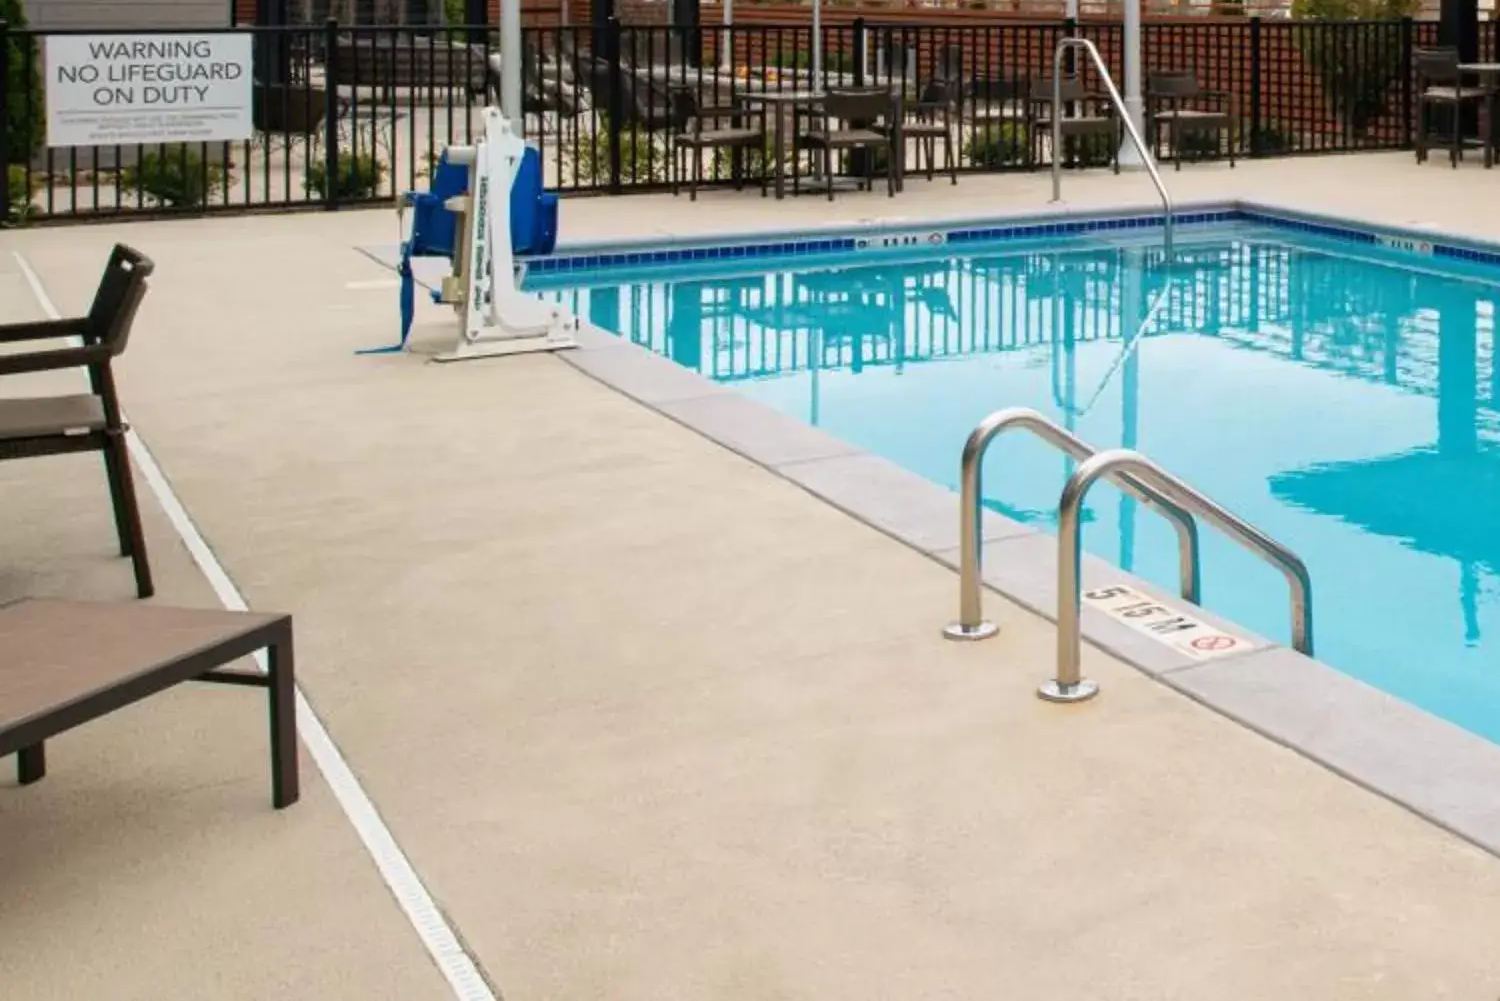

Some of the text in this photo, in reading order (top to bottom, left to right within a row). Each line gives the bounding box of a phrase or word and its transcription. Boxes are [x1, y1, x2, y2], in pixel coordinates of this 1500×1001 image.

[89, 40, 211, 60] WARNING
[57, 62, 242, 83] NO LIFEGUARD
[93, 86, 209, 105] ON DUTY
